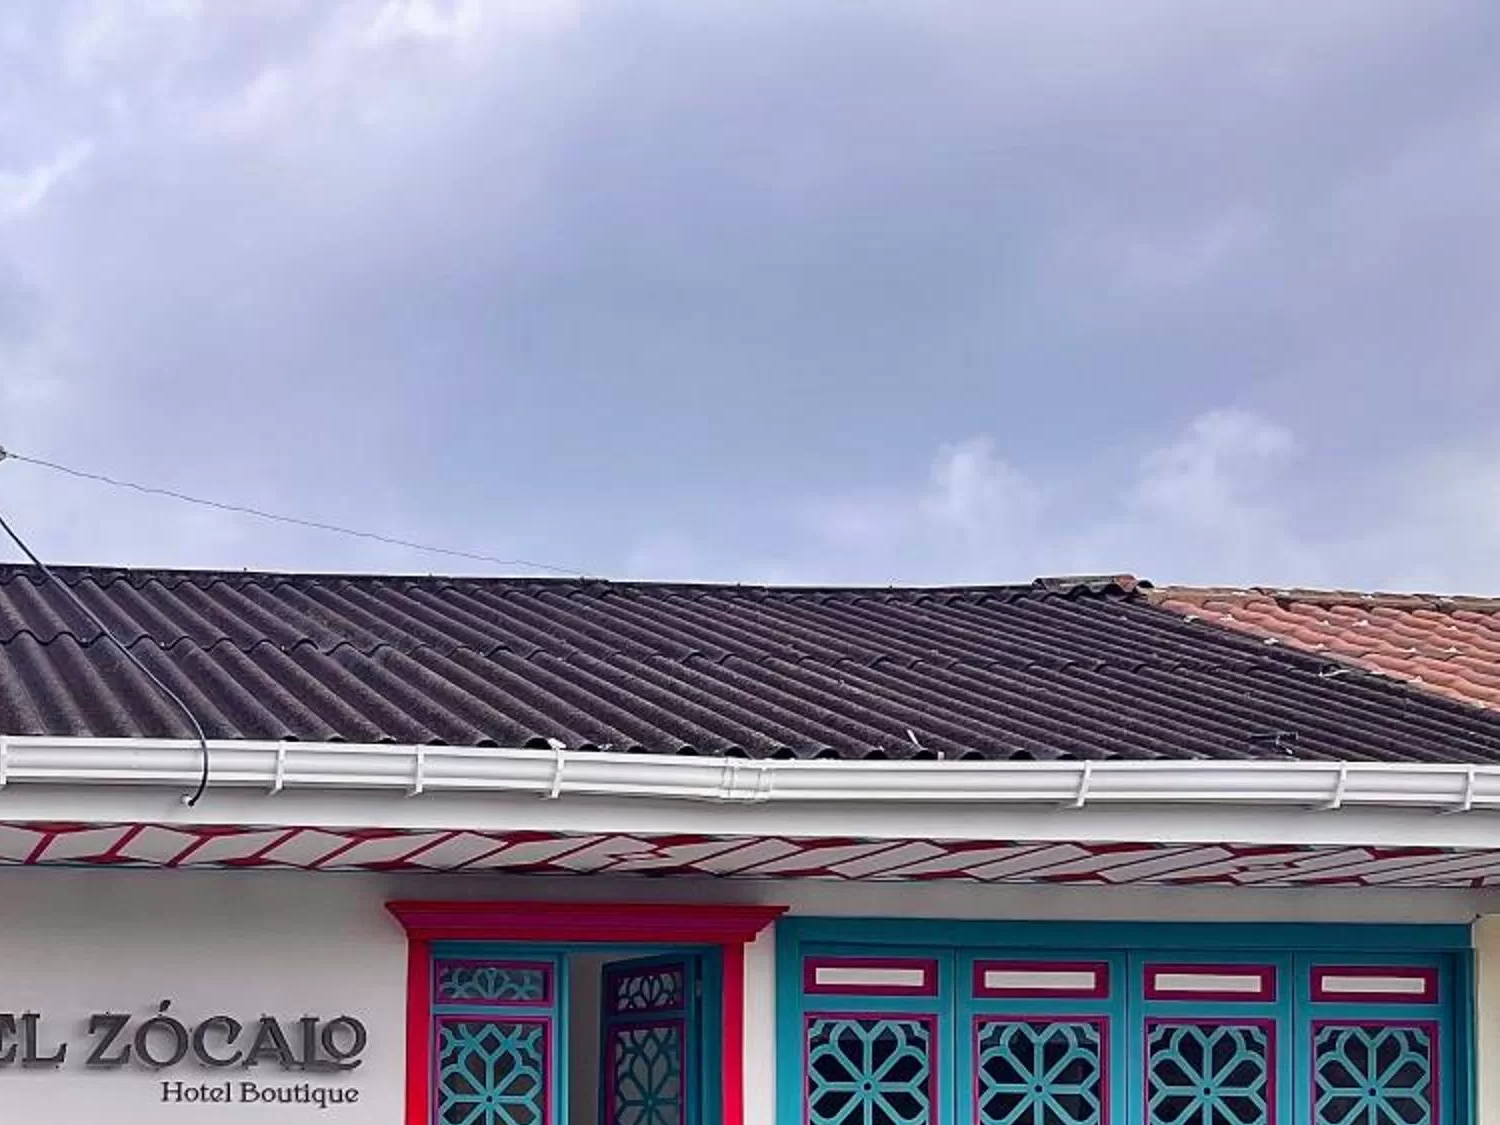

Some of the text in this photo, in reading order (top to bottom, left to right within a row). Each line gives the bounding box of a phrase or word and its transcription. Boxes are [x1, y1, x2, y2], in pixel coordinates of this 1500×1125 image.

[86, 999, 368, 1070] ZÓCALO
[161, 1081, 360, 1108] Hotel Boutique
